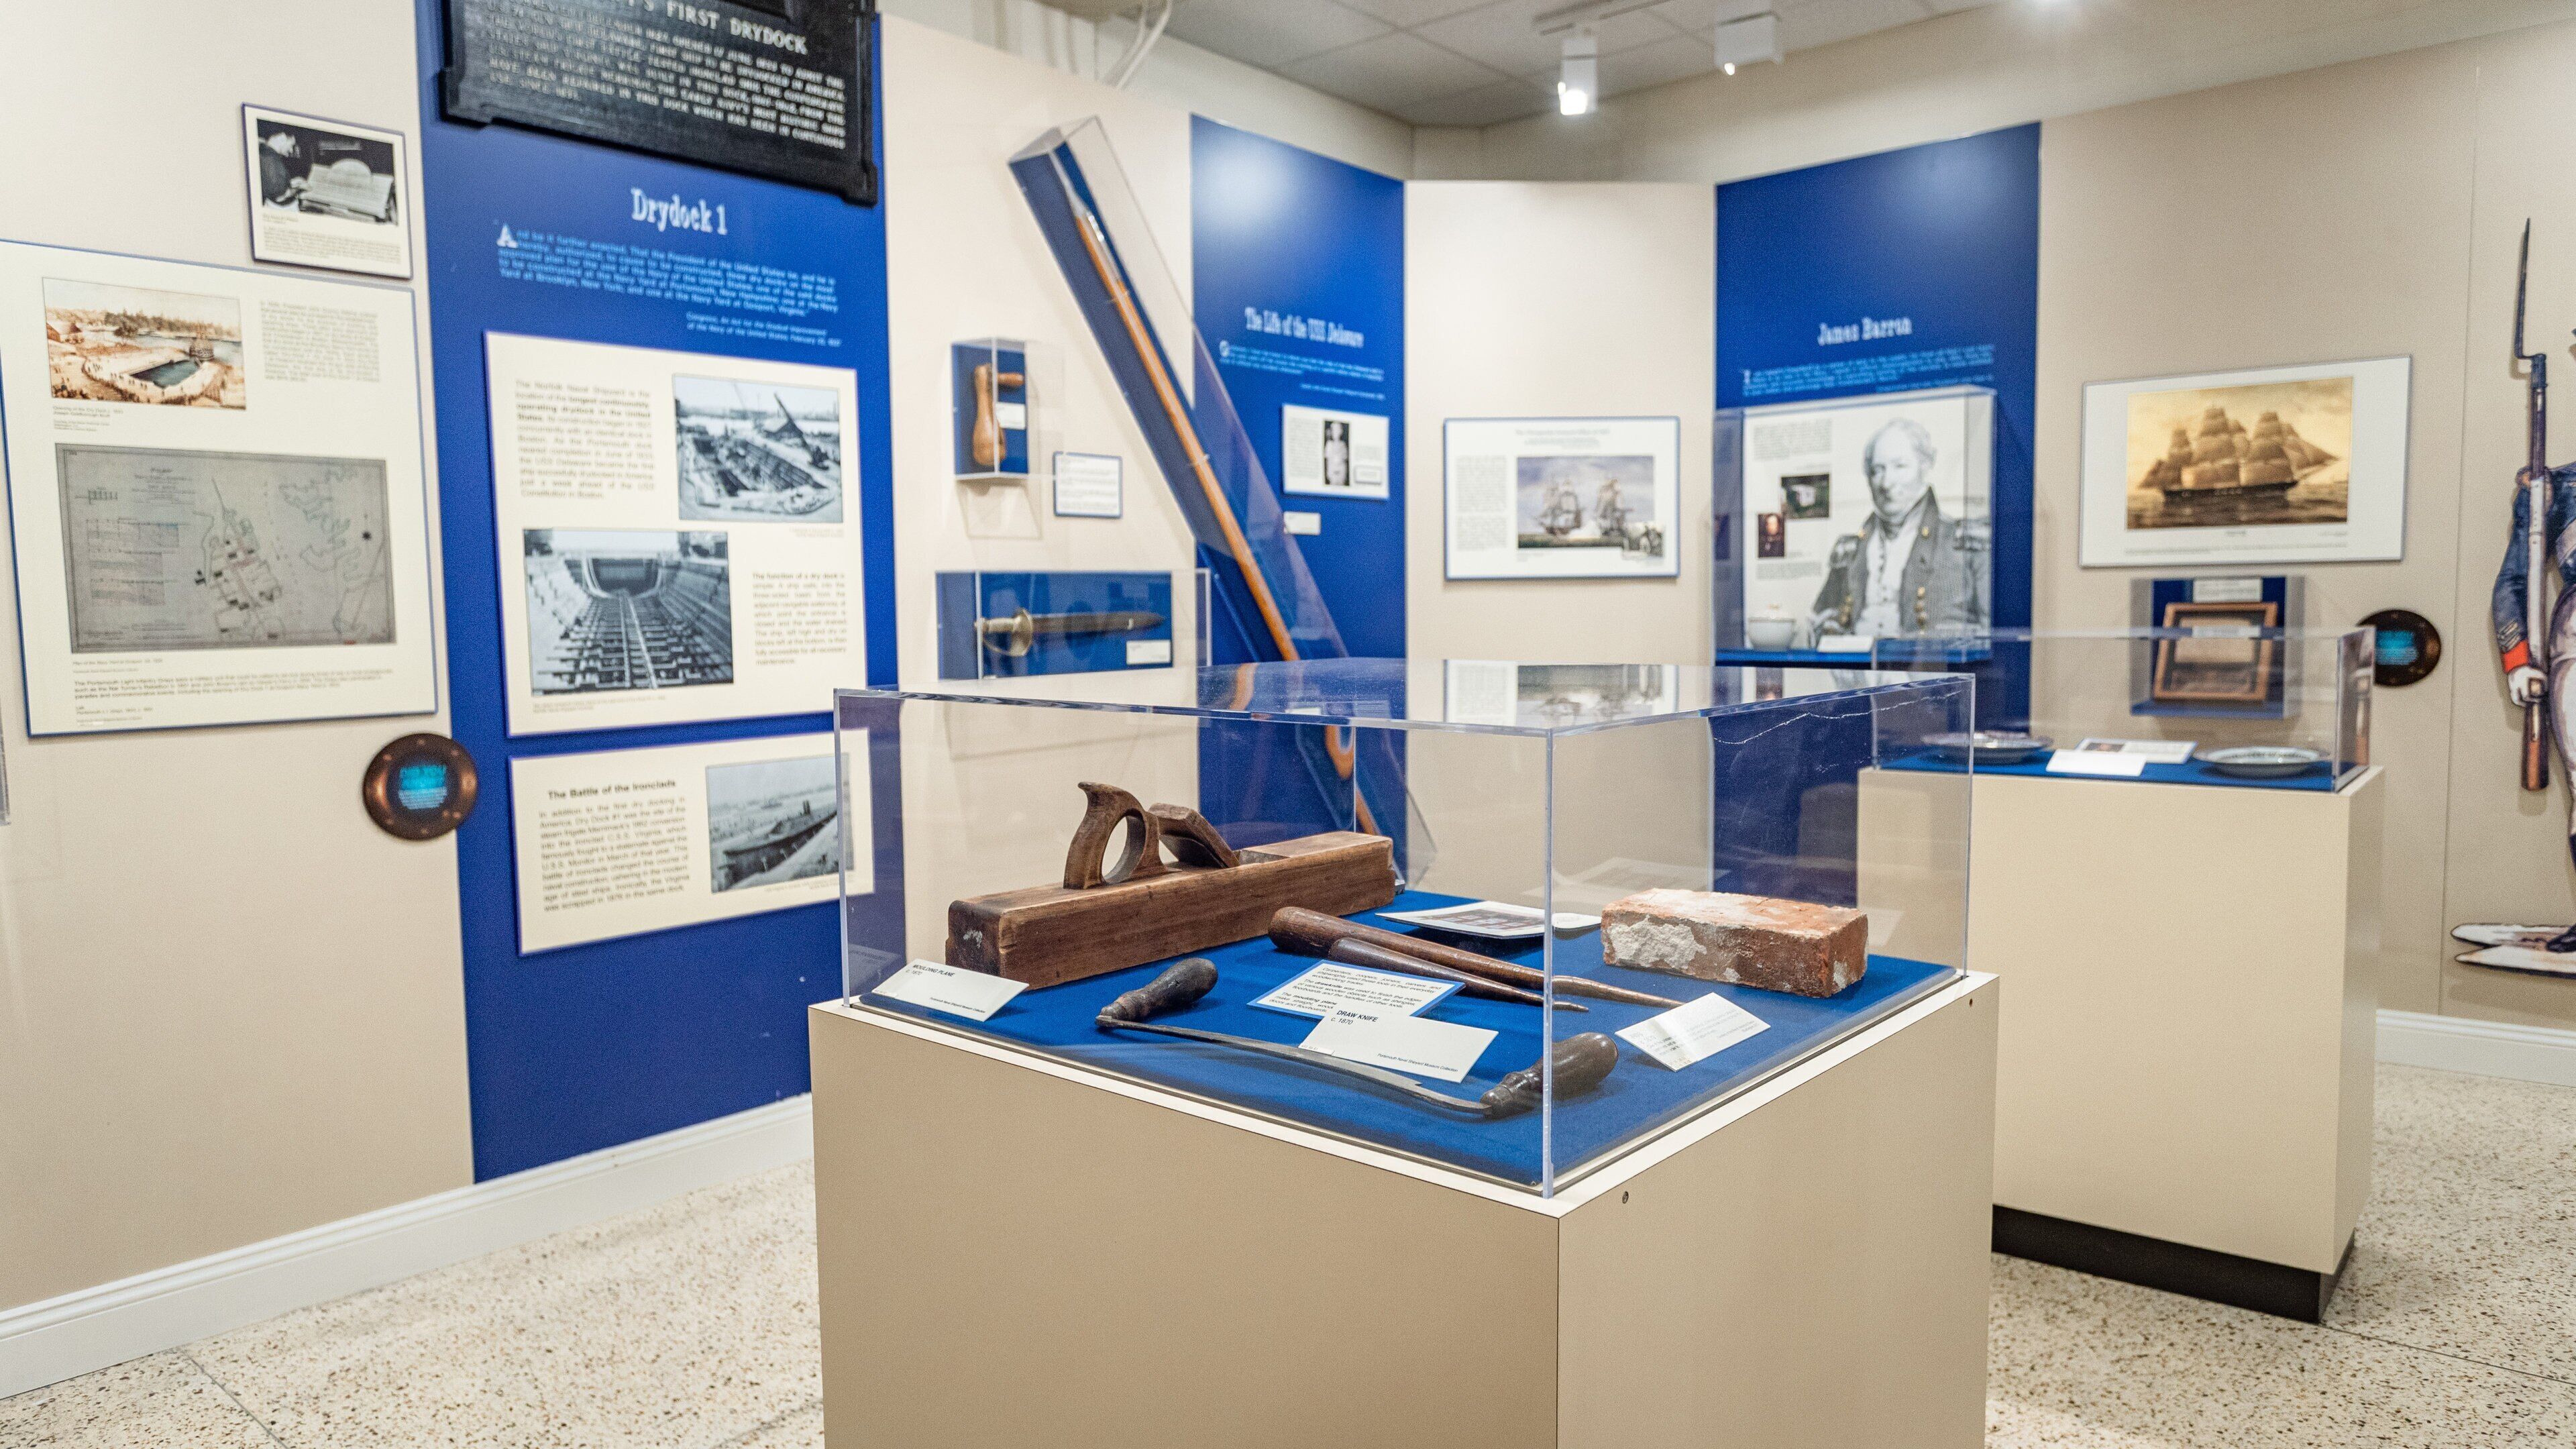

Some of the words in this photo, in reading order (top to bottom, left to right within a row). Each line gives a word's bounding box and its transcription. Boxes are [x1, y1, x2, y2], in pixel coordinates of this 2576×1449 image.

[666, 1, 720, 30] FIRST
[730, 17, 808, 55] DRYDOCK
[631, 187, 713, 233] Drydock
[716, 203, 727, 235] 1
[1263, 309, 1282, 335] Life
[1817, 323, 1859, 346] James
[1860, 317, 1913, 341] Barron
[548, 789, 566, 799] The
[570, 787, 598, 798] Battle
[602, 785, 612, 794] of
[614, 783, 629, 792] the
[633, 780, 676, 791] Ironclads
[912, 964, 938, 973] MOULDING
[1336, 1010, 1358, 1018] DRAW
[1358, 1014, 1379, 1022] KNIFE
